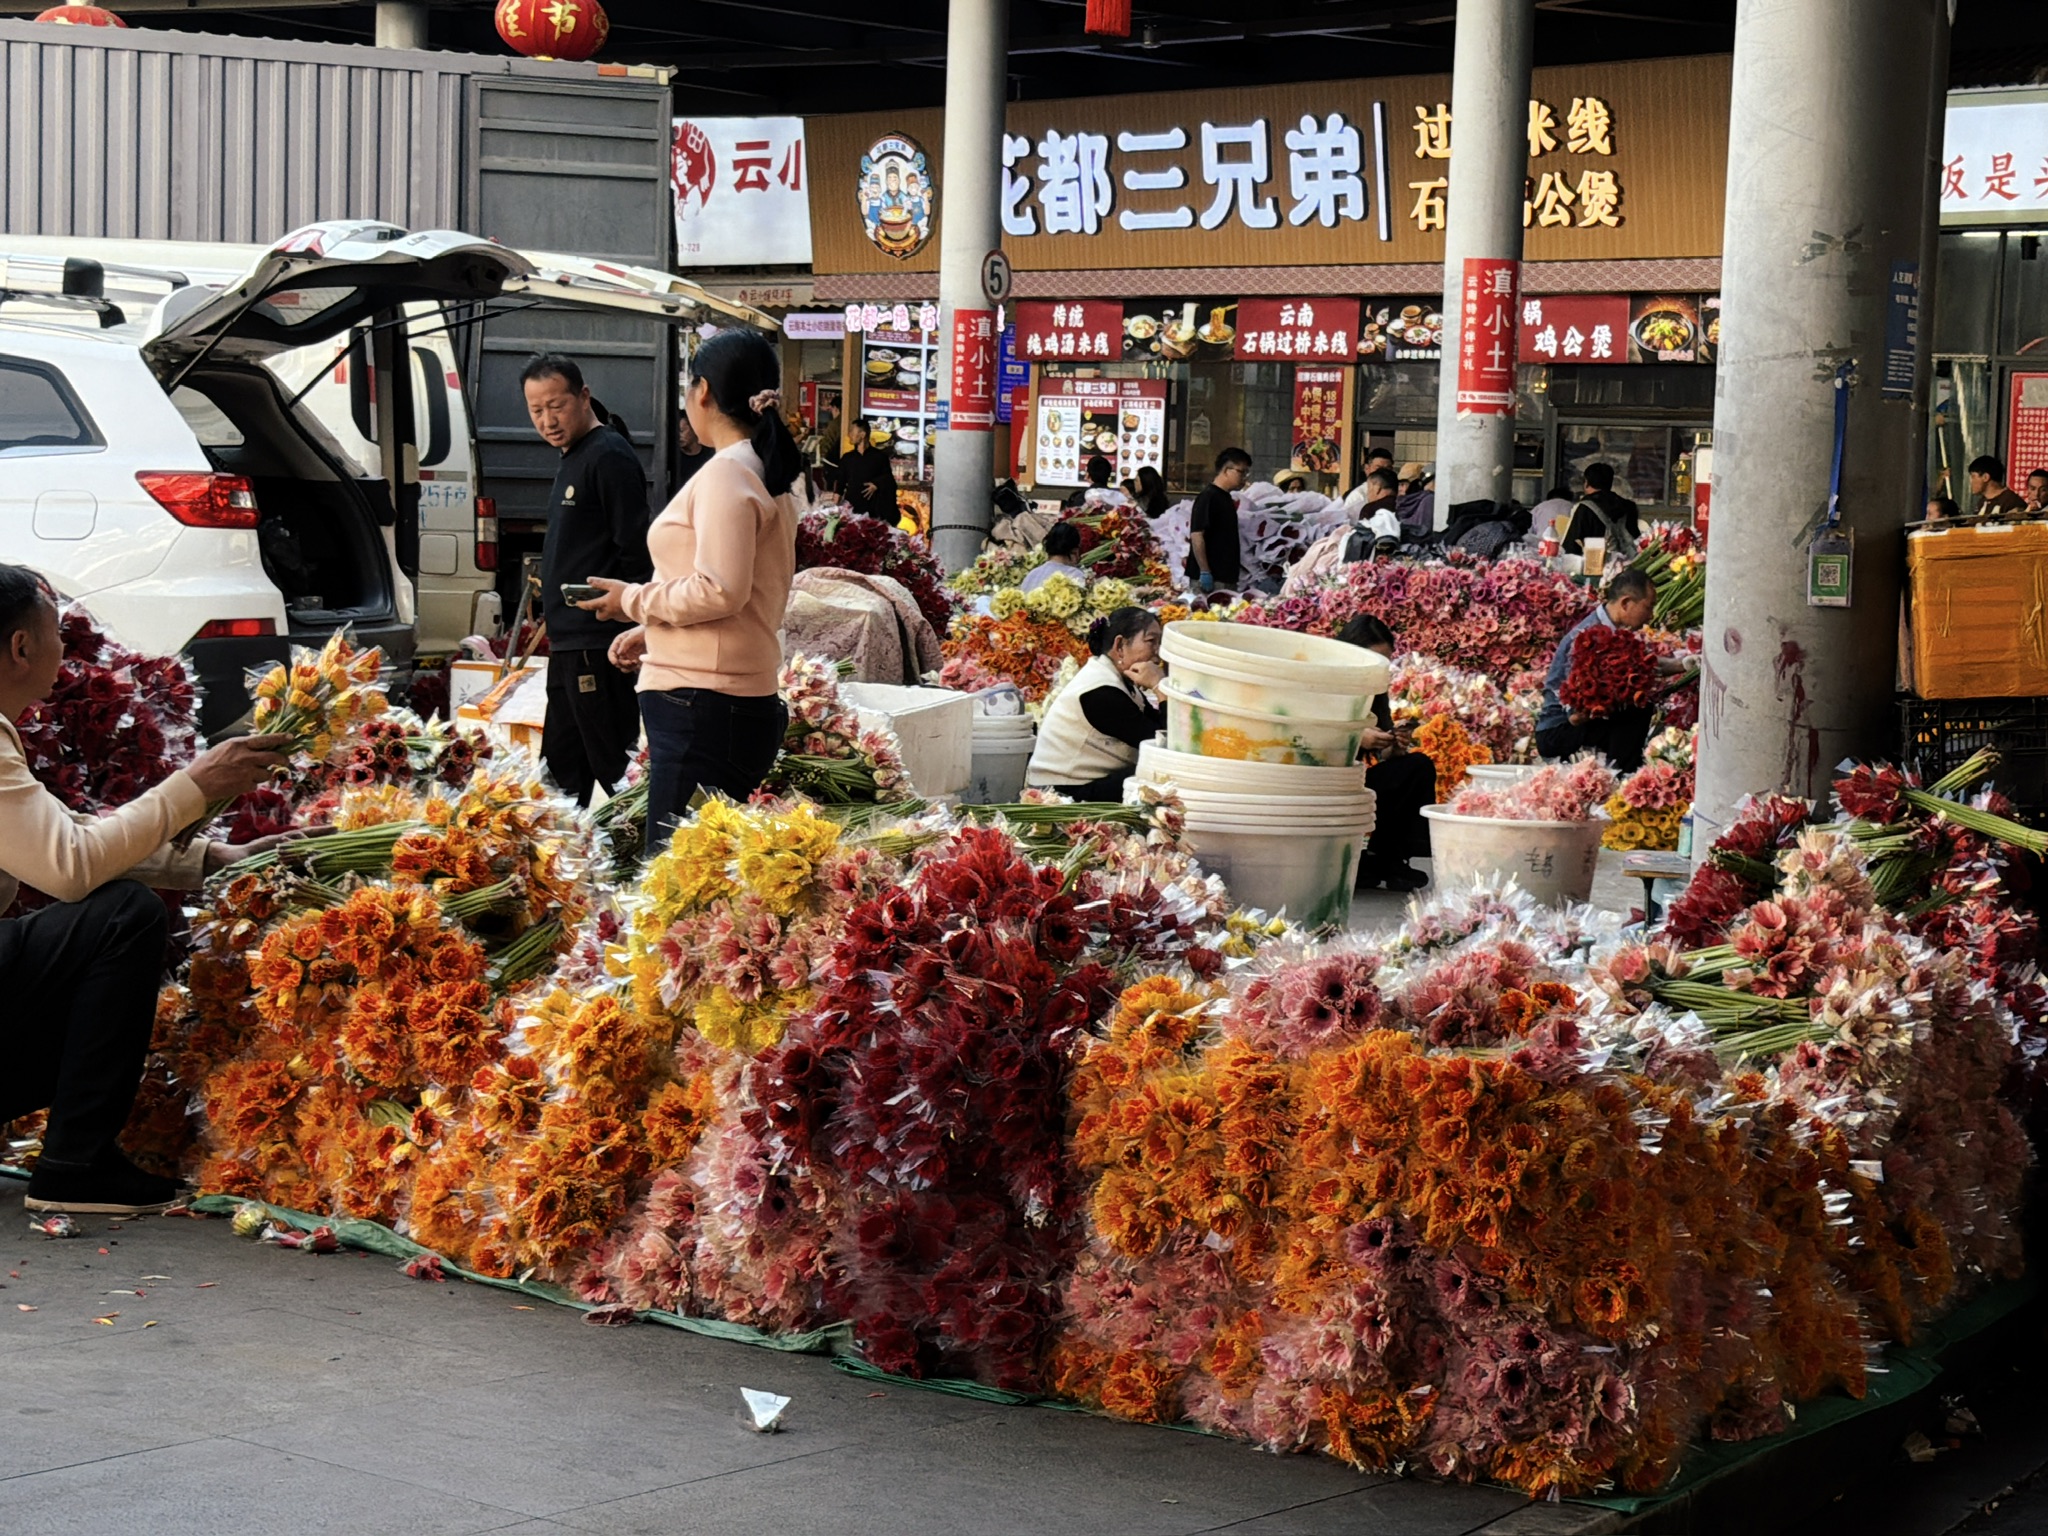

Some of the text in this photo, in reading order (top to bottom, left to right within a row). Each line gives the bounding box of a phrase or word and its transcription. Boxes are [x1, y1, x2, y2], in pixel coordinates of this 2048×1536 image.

[1413, 97, 1611, 158] 过米线
[989, 260, 1002, 295] 5
[846, 304, 910, 332] 花都一绝
[1053, 304, 1085, 328] 传统
[1279, 304, 1315, 328] 云南
[1483, 268, 1513, 371] 滇小土
[969, 316, 992, 398] 滇小土
[1026, 332, 1110, 356] 纯鸡汤米线
[1241, 332, 1349, 356] 石锅过桥米线
[1533, 324, 1614, 359] 鸡公煲
